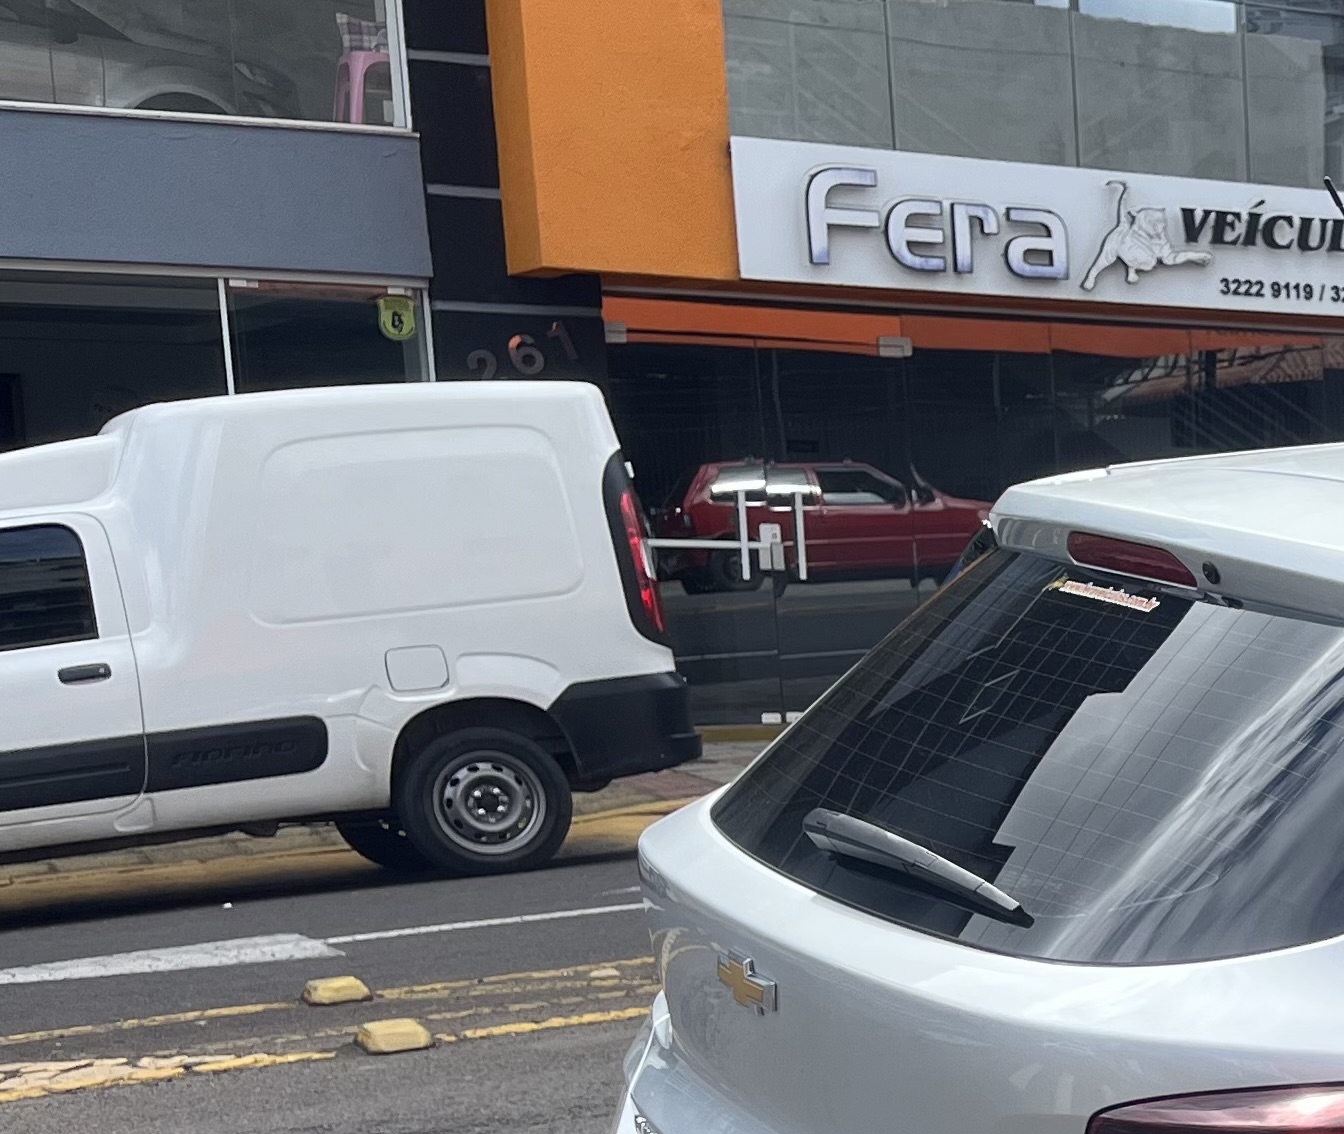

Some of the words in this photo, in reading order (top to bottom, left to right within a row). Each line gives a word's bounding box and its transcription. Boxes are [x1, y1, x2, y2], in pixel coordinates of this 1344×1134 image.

[1219, 277, 1265, 298] 3222
[1270, 281, 1313, 301] 9119
[465, 319, 579, 380] 261
